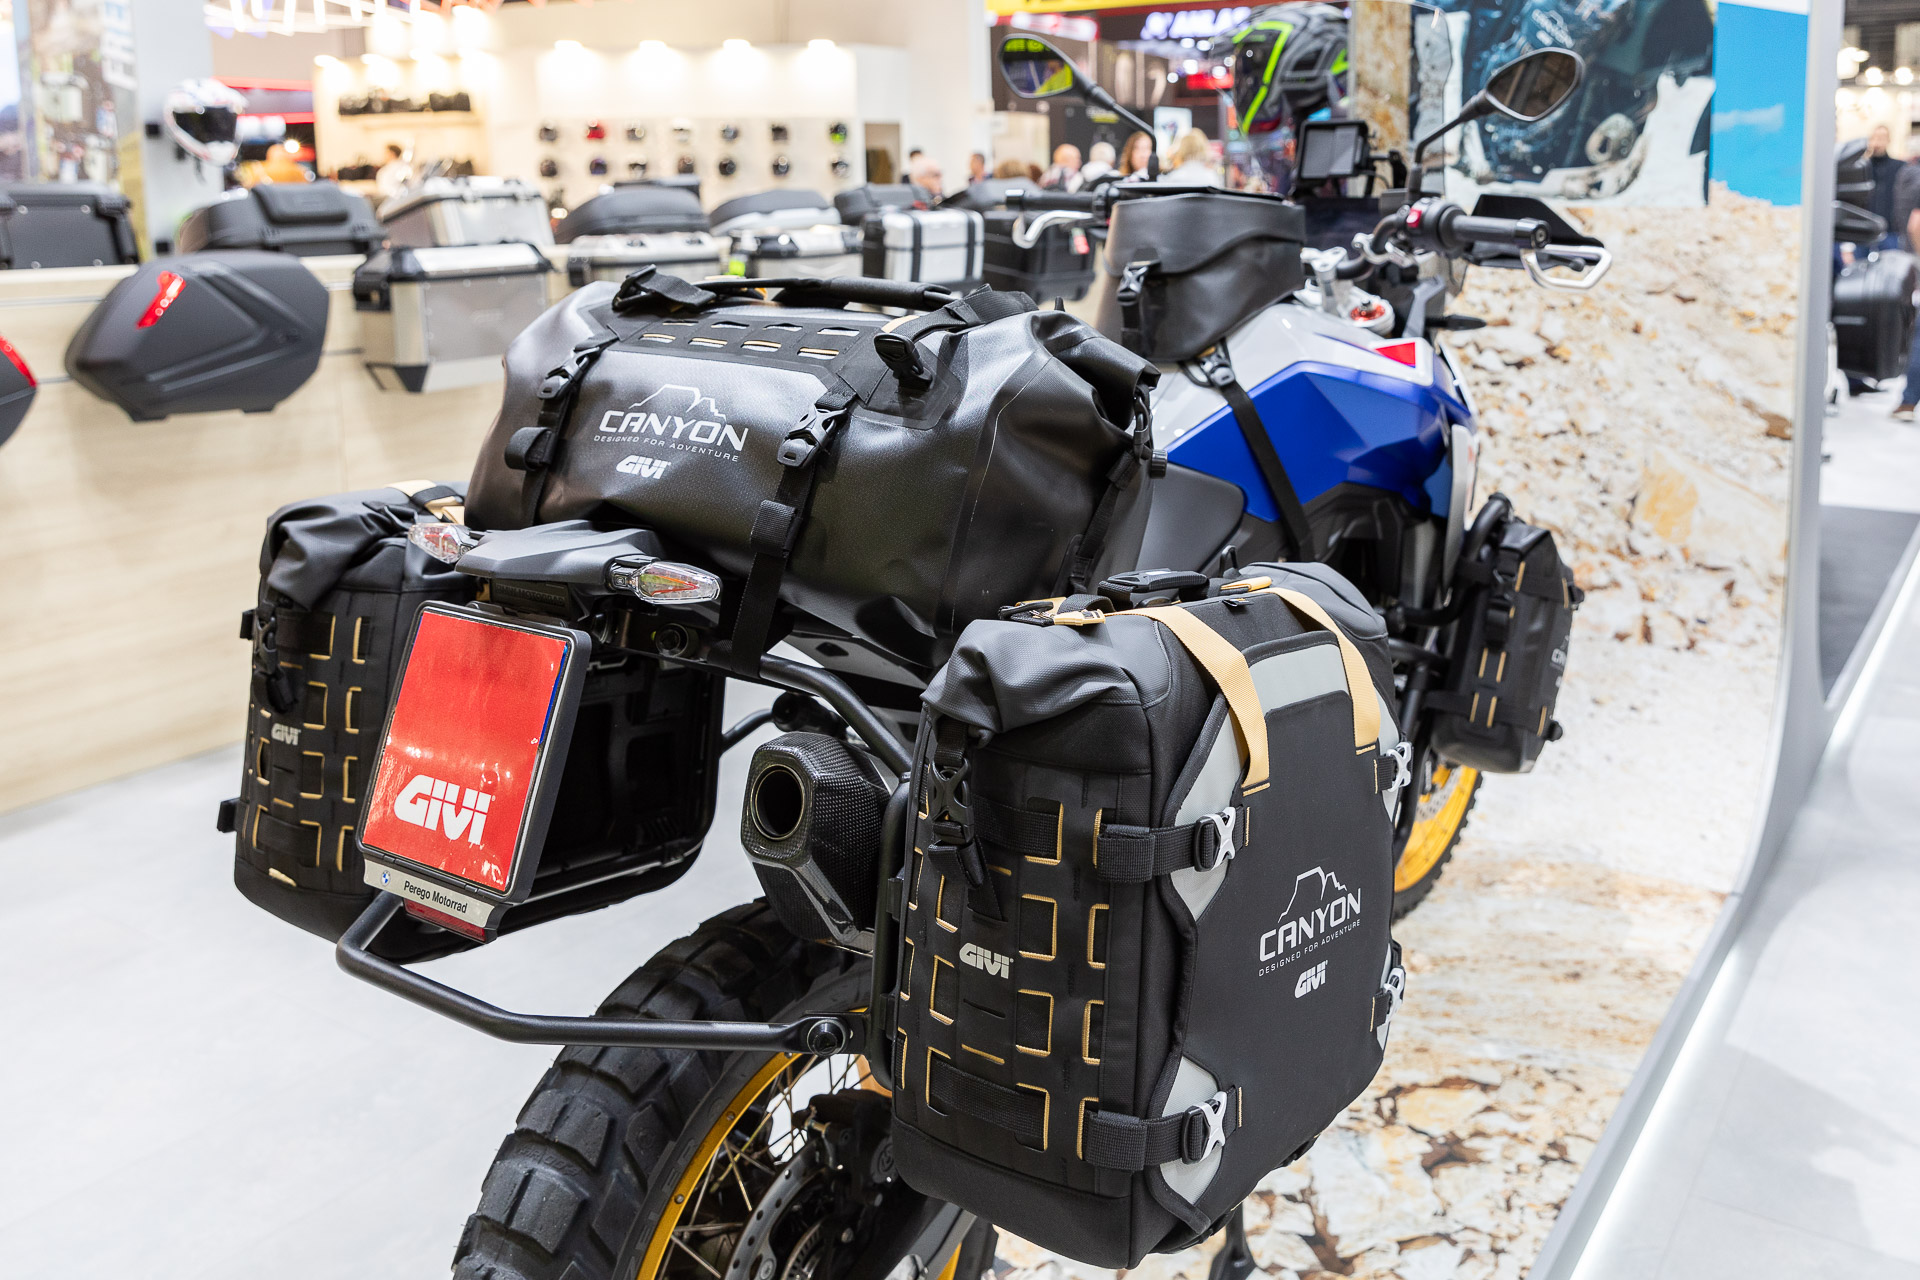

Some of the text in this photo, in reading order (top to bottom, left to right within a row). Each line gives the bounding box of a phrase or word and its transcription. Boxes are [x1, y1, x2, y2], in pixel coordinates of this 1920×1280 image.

[593, 434, 739, 463] DESIGNED FOR ADVENTURE
[599, 410, 749, 452] CANYON
[616, 454, 669, 480] GIVI
[271, 722, 300, 746] GIVI
[394, 774, 492, 846] GIVI
[403, 880, 468, 914] Perego Motorrad
[1259, 887, 1361, 962] CANYON
[959, 942, 1010, 980] GIVI
[1258, 918, 1361, 977] DESIGNED FOR ADVENTURE
[1294, 960, 1327, 999] GIVI
